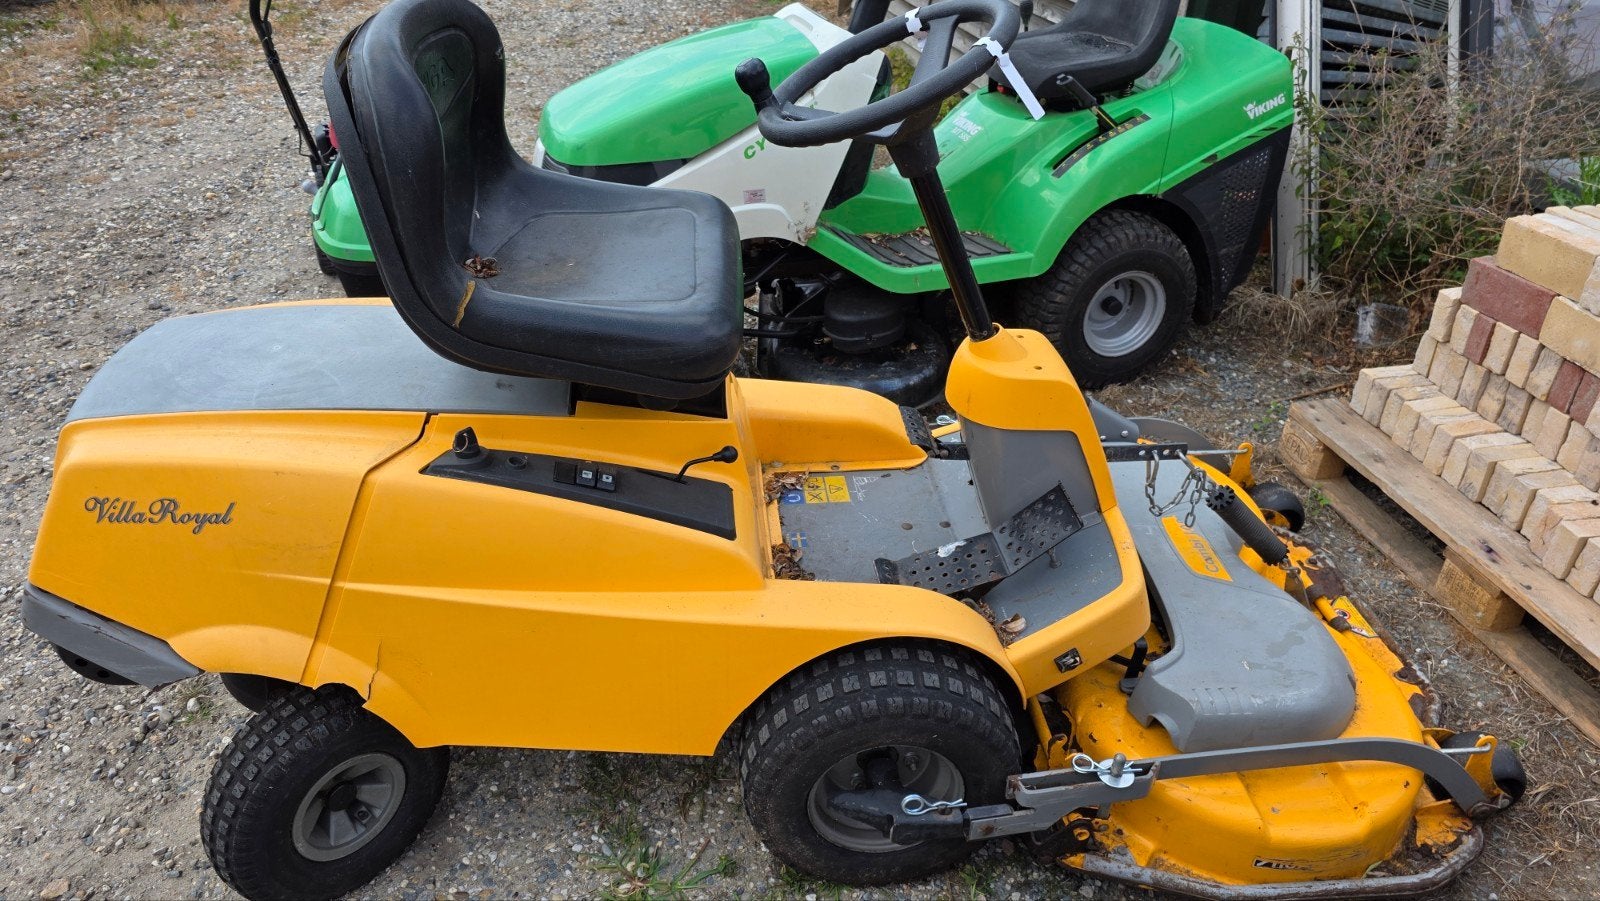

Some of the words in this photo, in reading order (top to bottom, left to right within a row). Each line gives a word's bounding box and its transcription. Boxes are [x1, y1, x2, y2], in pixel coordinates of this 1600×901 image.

[1246, 93, 1286, 120] VIKING
[952, 116, 983, 136] VIKING
[743, 136, 766, 159] CY
